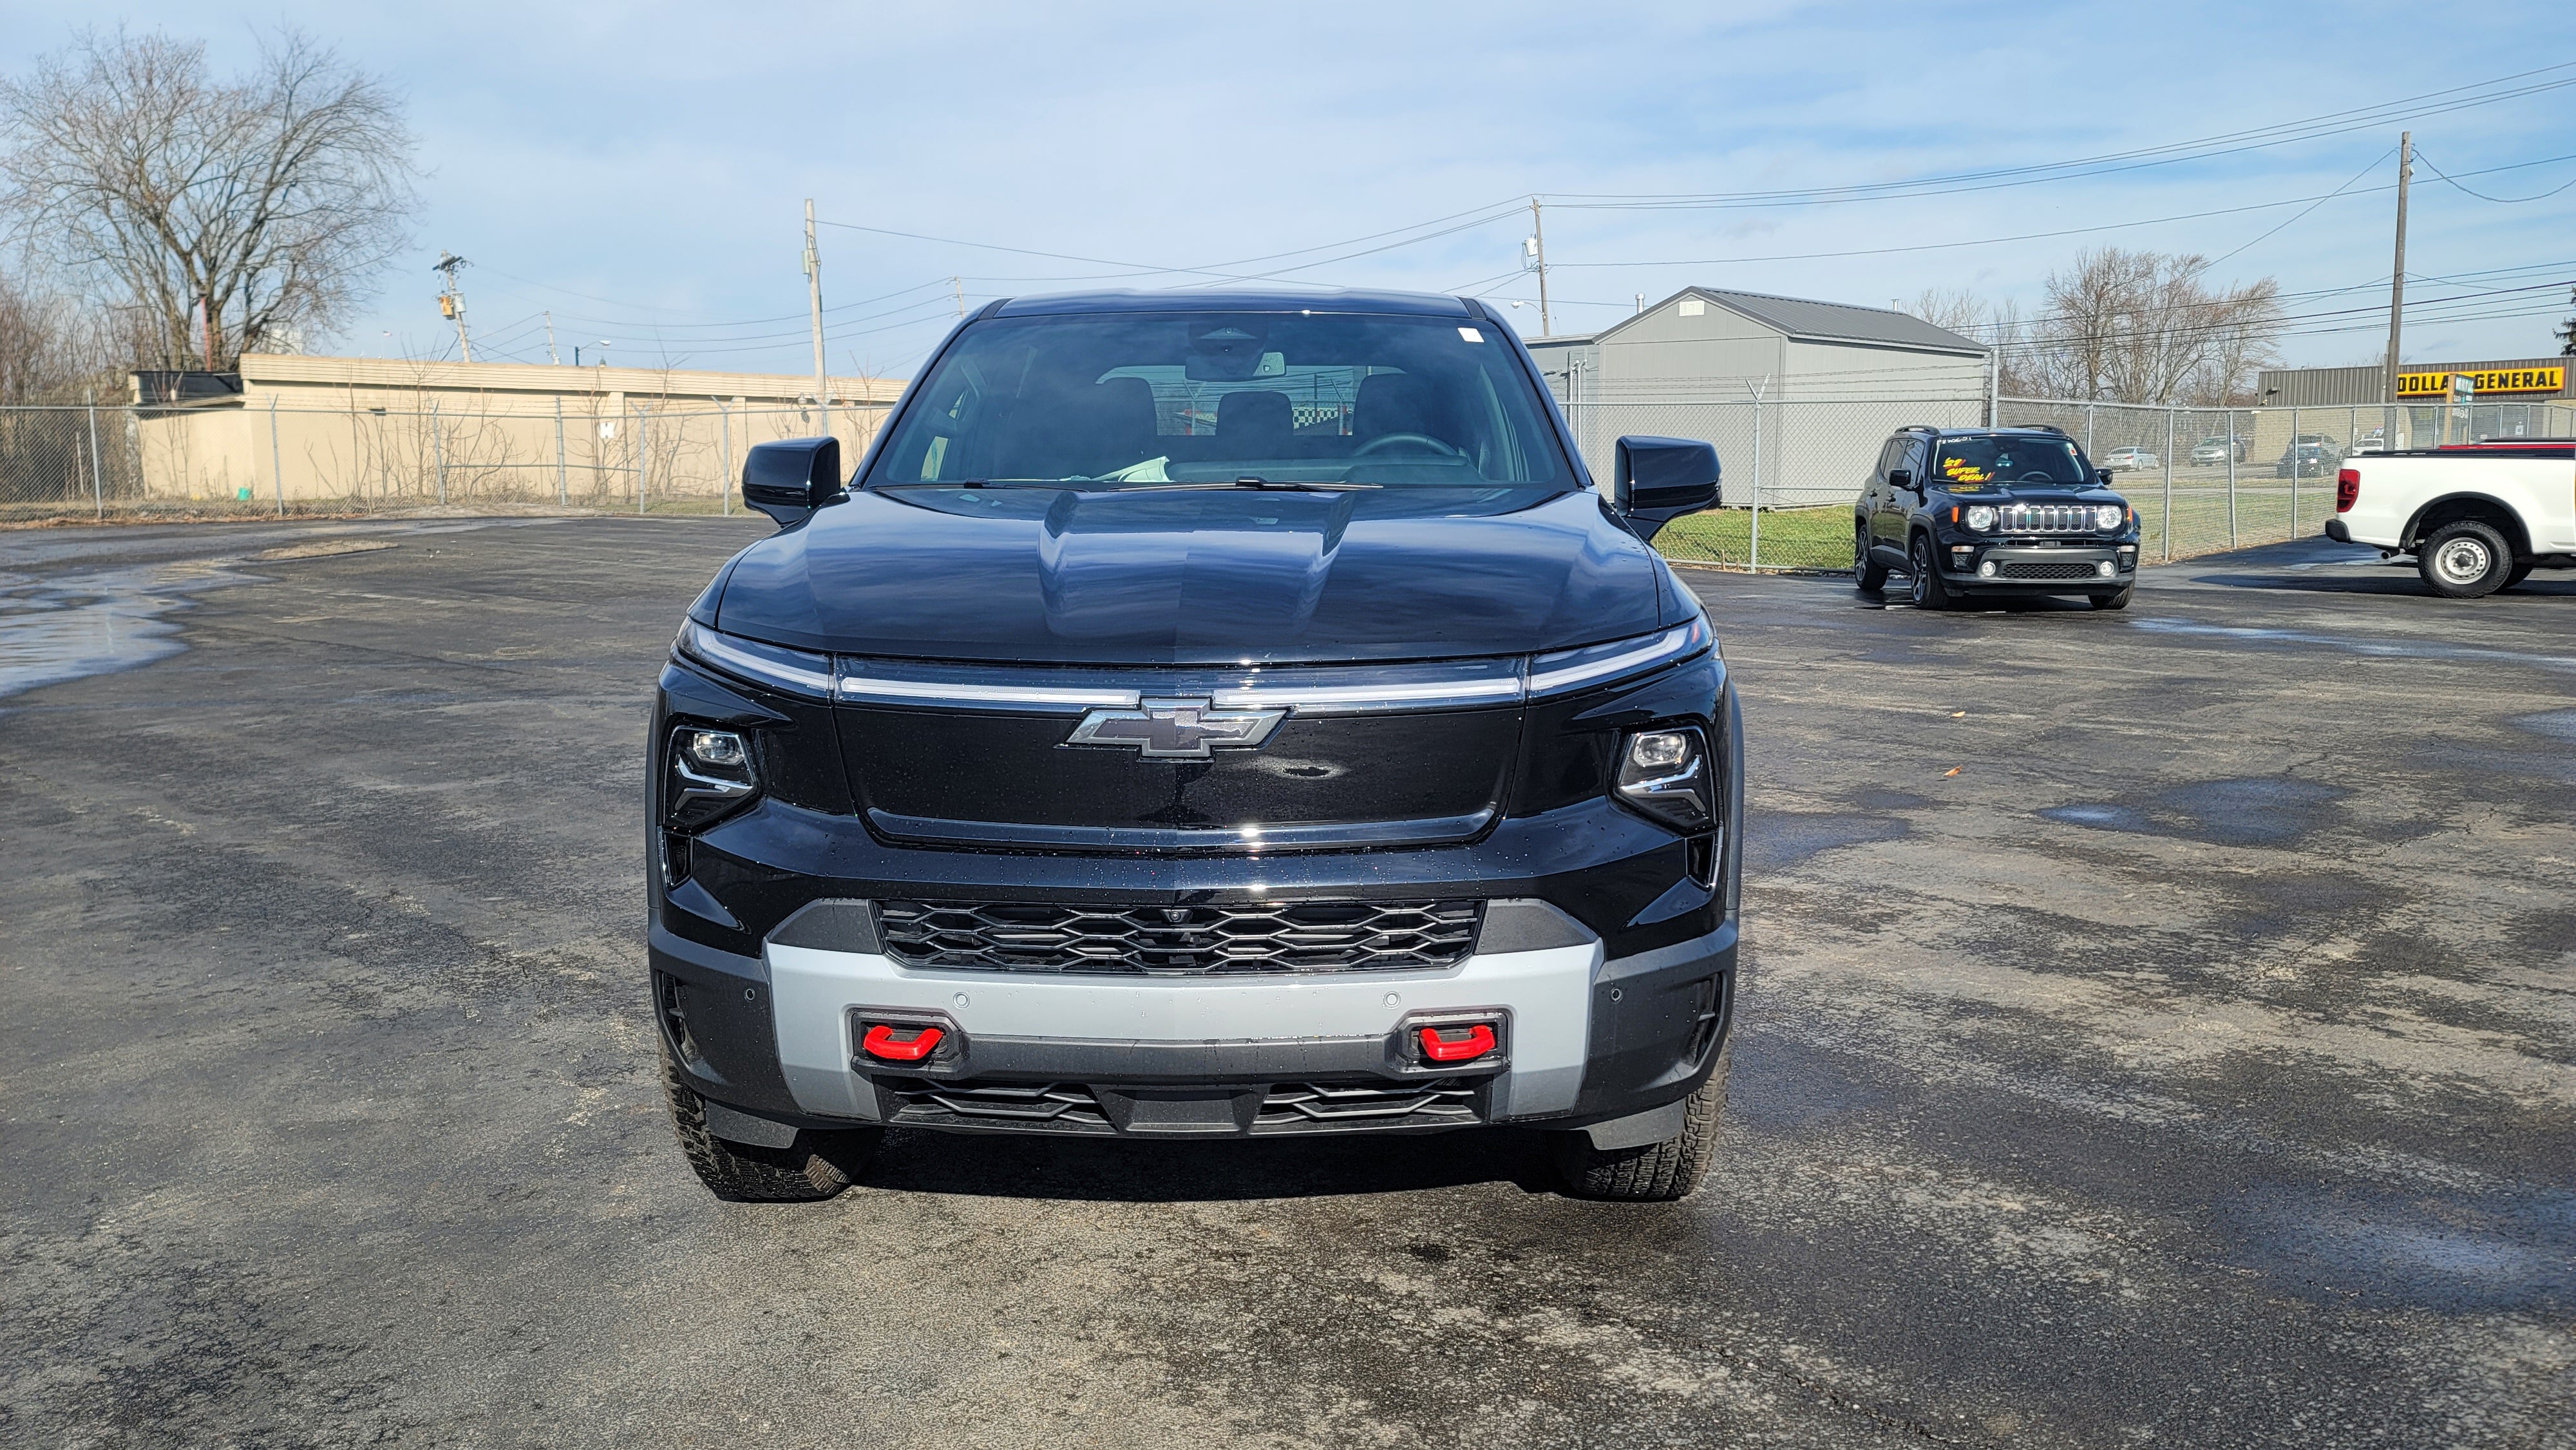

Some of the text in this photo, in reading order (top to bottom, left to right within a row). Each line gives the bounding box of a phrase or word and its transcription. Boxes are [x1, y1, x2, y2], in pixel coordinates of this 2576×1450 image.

[2398, 375, 2448, 391] DOLLA
[2474, 371, 2557, 389] GENERAL
[1946, 467, 1981, 476] SUPER
